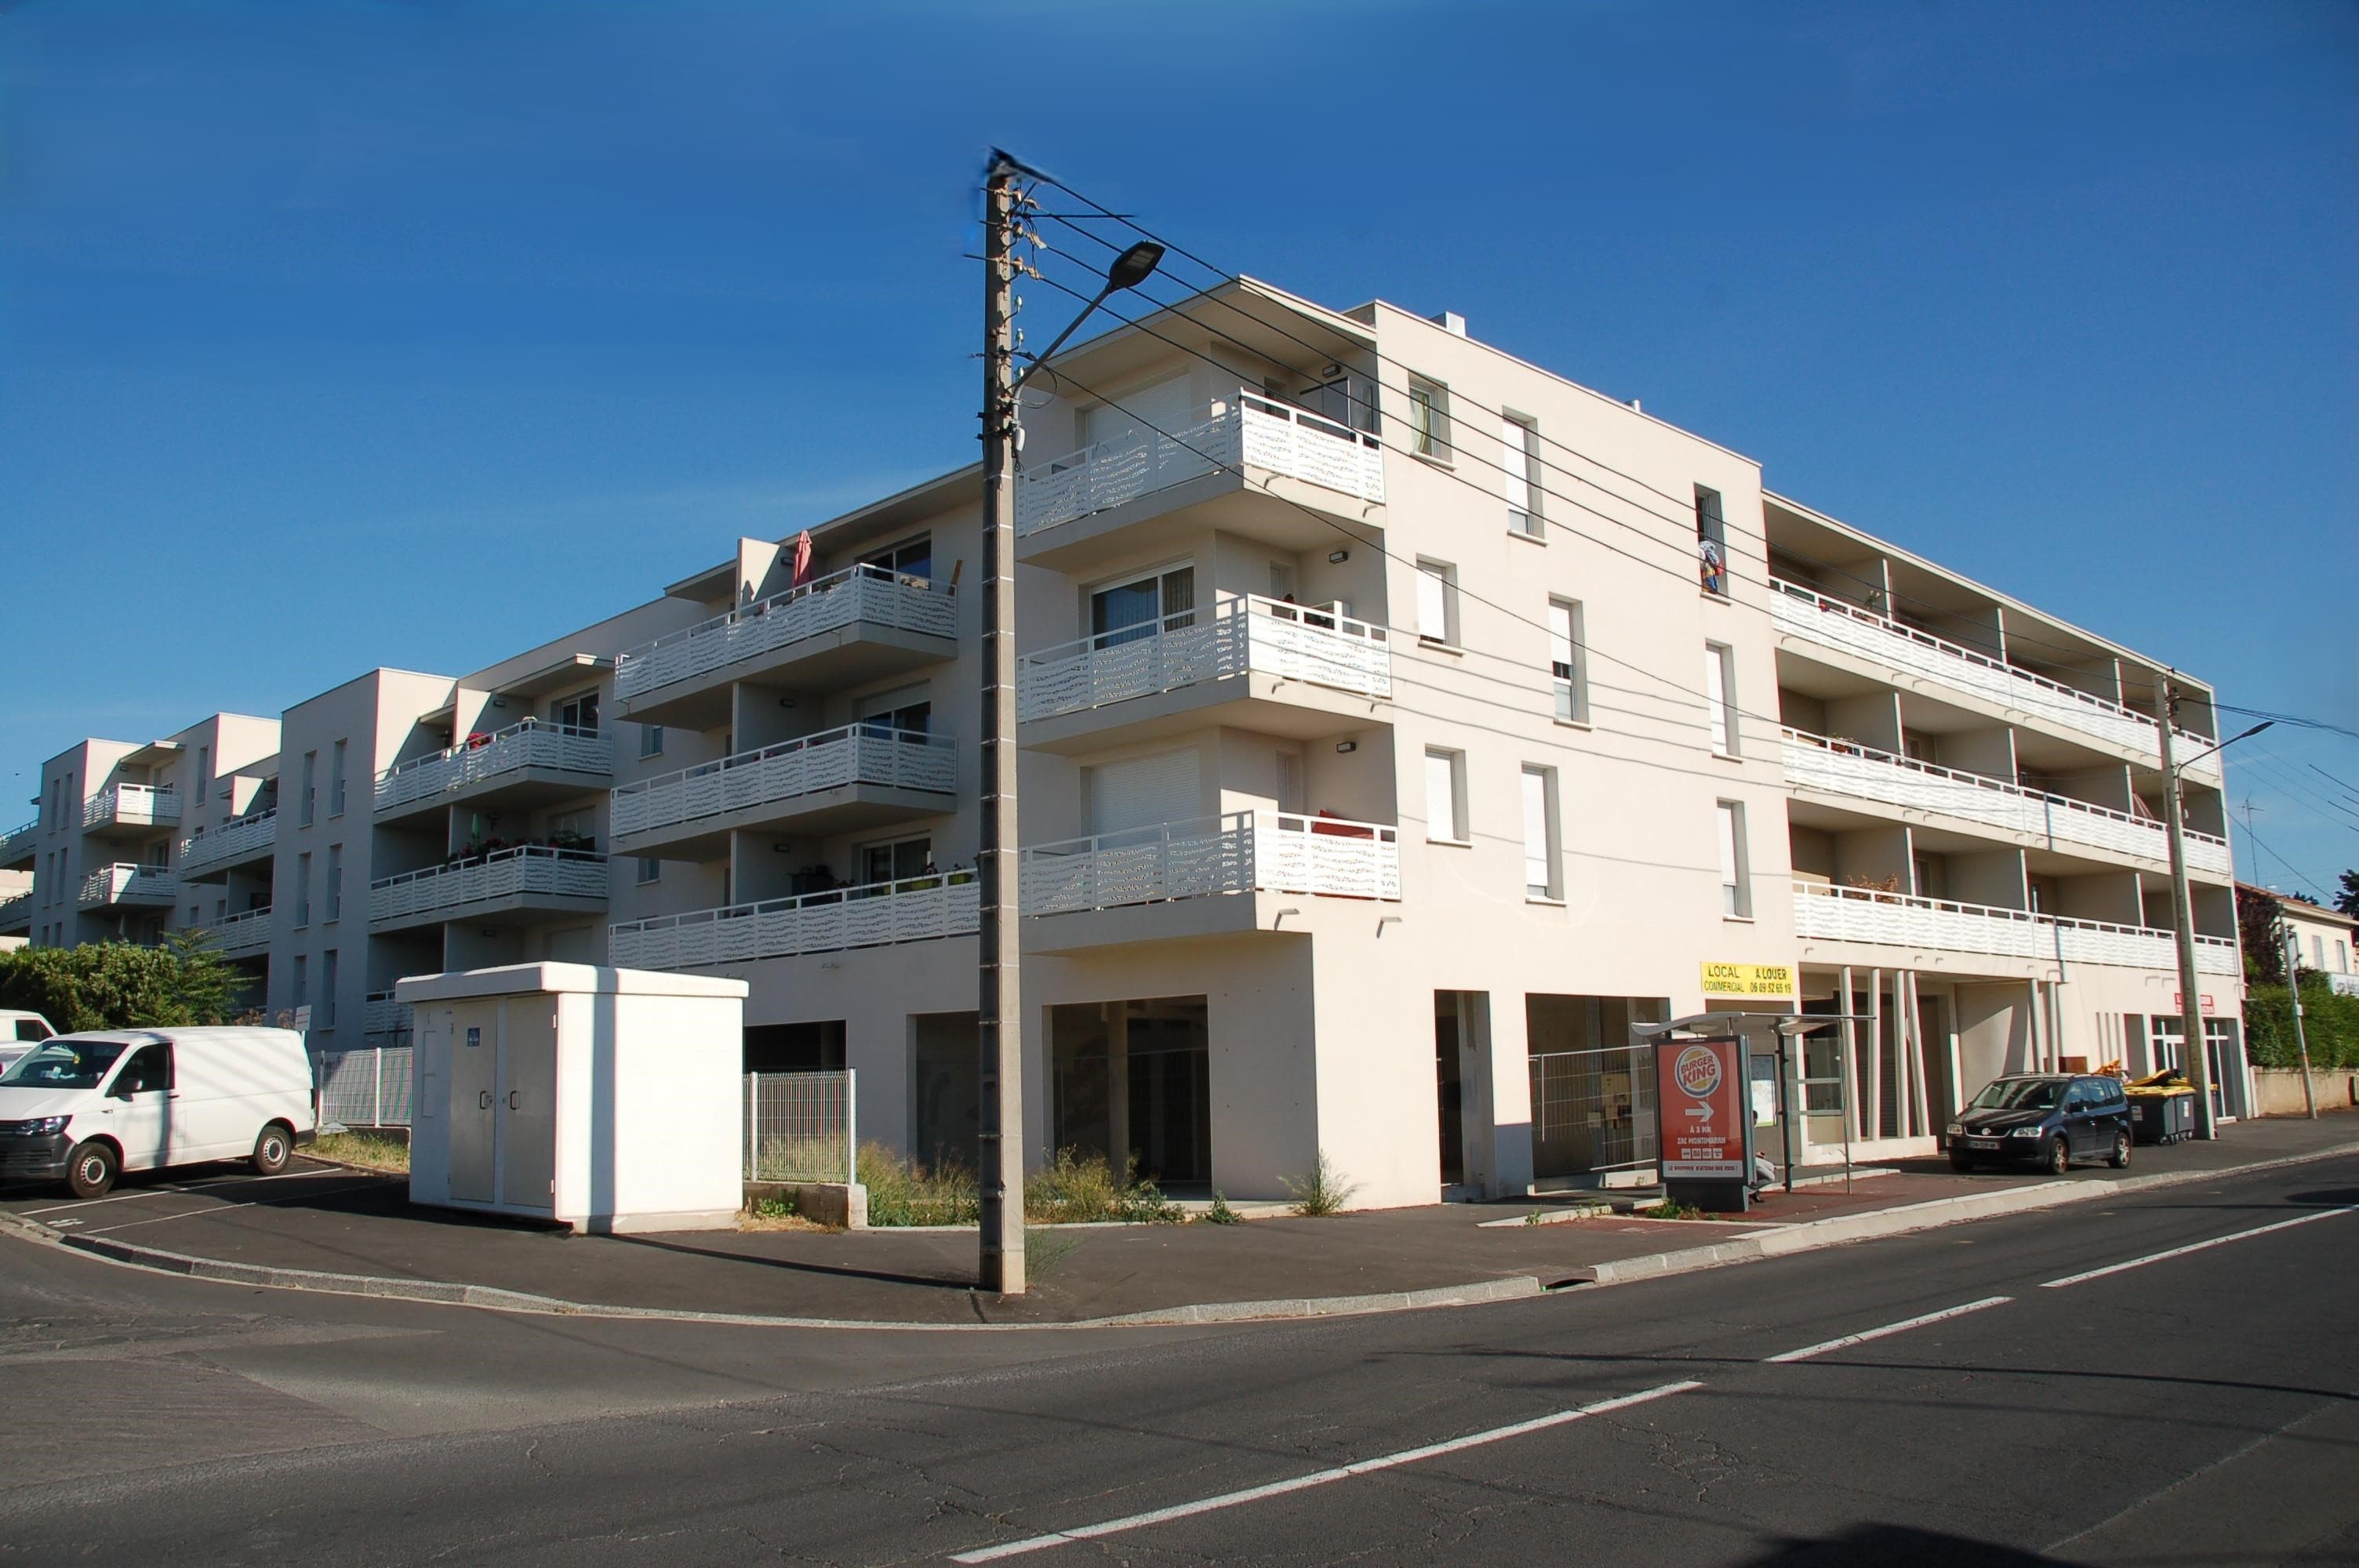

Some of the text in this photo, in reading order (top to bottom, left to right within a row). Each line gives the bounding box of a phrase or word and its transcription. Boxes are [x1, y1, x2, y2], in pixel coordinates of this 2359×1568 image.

[1708, 965, 1787, 980] LOCAL A LOUER
[1704, 980, 1744, 993] COMMERCIAL
[1750, 982, 1757, 993] 06
[1759, 982, 1766, 993] 09
[1768, 983, 1775, 993] 52
[1681, 1055, 1714, 1074] BURGER
[1683, 1064, 1715, 1086] KING
